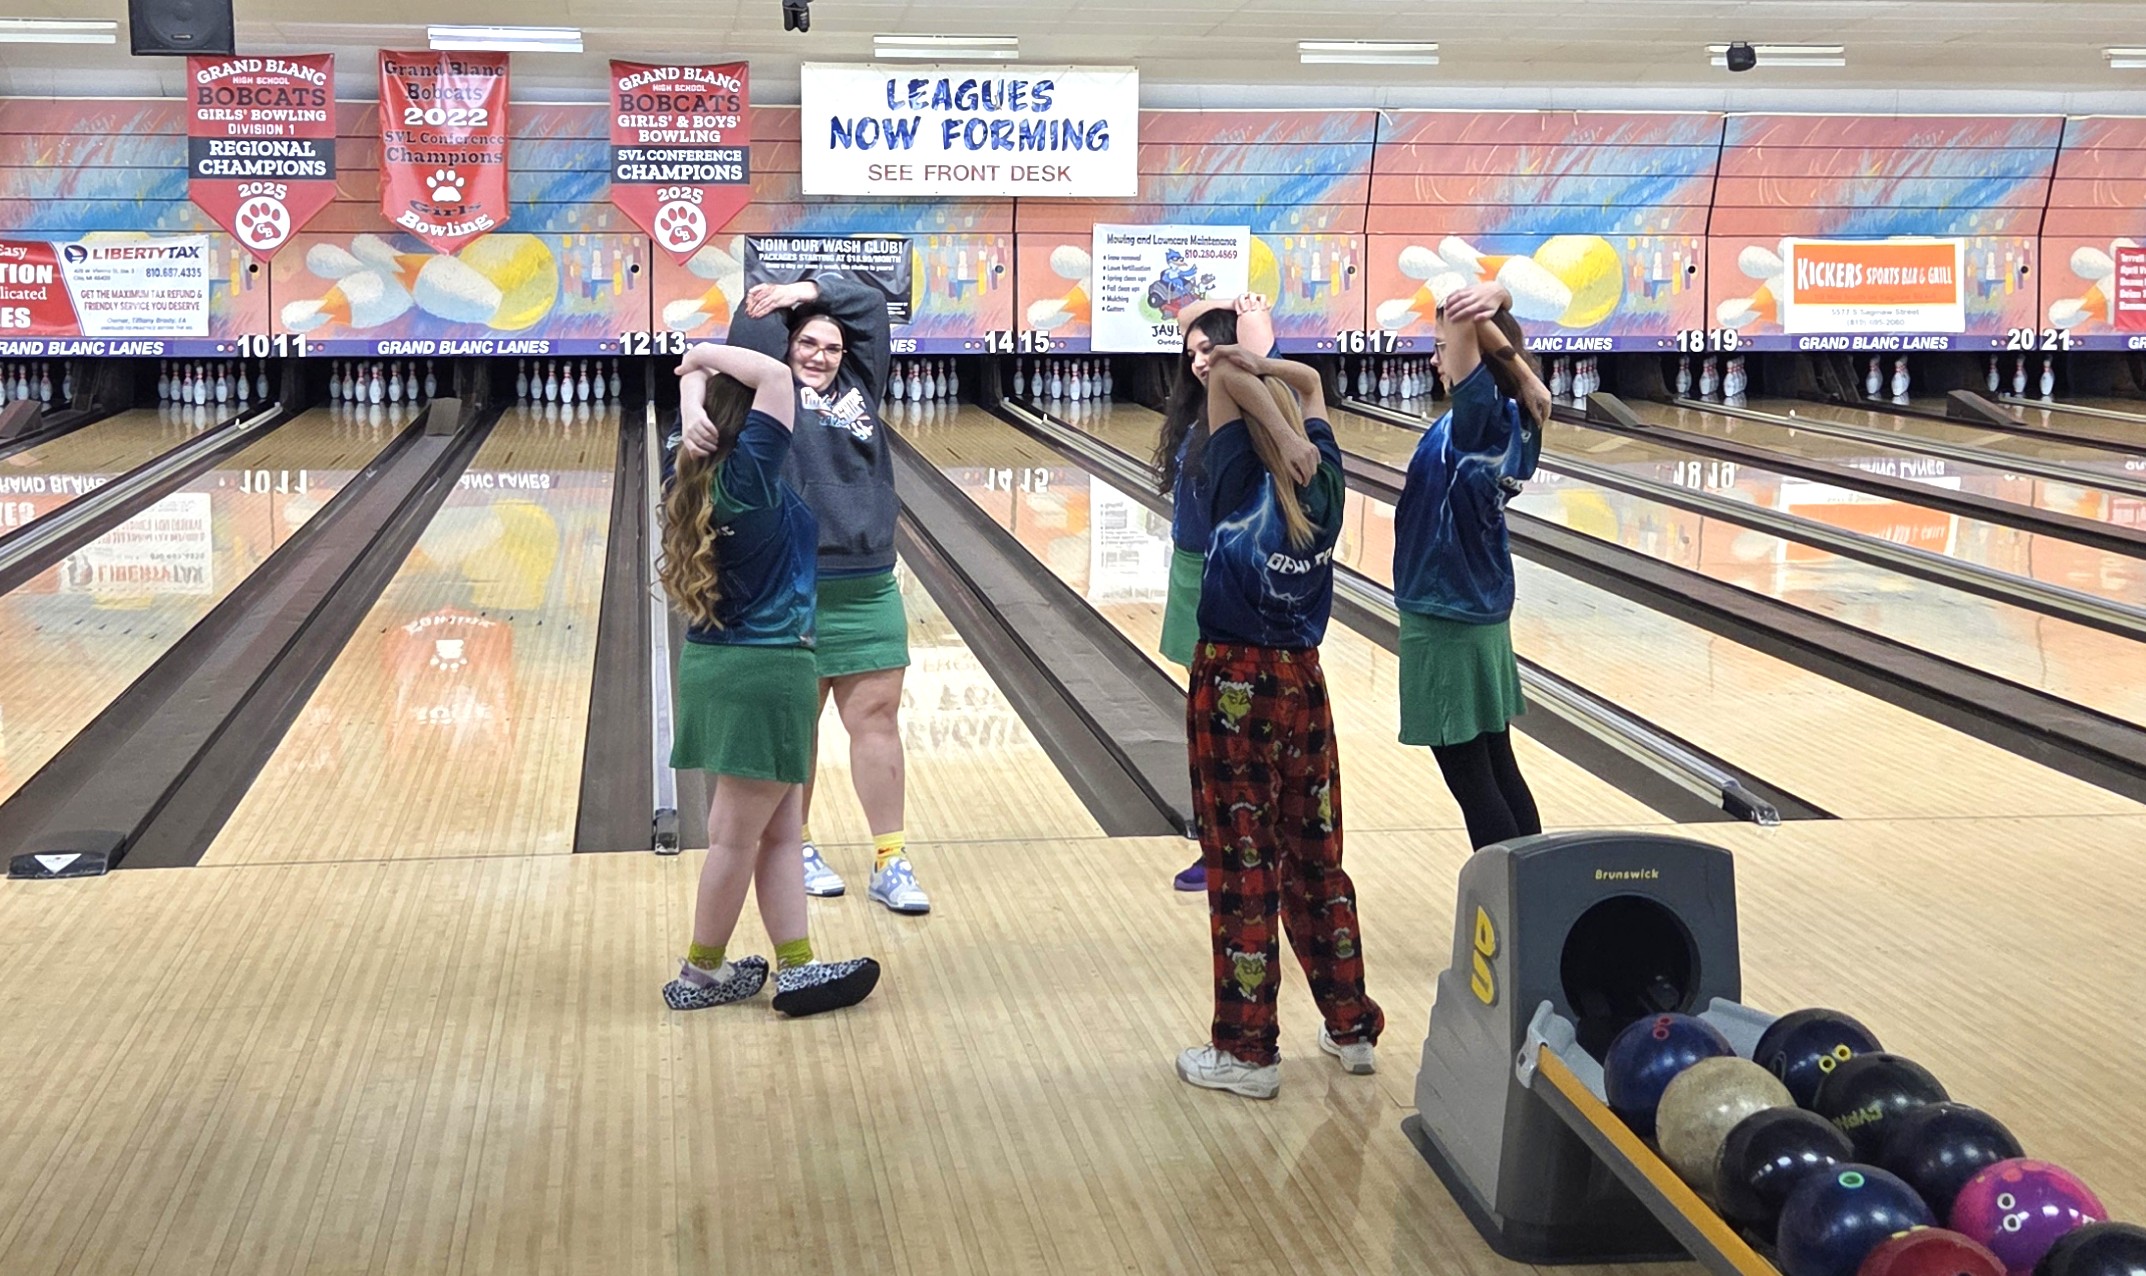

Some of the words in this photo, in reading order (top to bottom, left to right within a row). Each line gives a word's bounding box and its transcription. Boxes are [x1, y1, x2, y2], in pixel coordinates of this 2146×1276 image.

[196, 58, 263, 86] GRAND
[265, 58, 327, 86] BLANC
[384, 60, 442, 77] Grand
[450, 61, 505, 77] Blanc
[232, 77, 254, 85] HIGH
[256, 77, 290, 86] SCHOOL
[618, 66, 681, 92] GRAND
[683, 66, 742, 93] BLANC
[652, 84, 673, 92] HIGH
[674, 84, 707, 92] SCHOOL
[197, 87, 326, 107] BOBCATS
[405, 82, 483, 101] Bobcats
[886, 78, 1055, 112] LEAGUES
[618, 94, 741, 113] BOBCATS
[197, 109, 247, 121] GIRLS'
[251, 109, 327, 122] BOWLING
[404, 107, 488, 127] 2022
[617, 115, 673, 128] GIRLS'
[676, 115, 690, 128] &
[692, 115, 741, 129] BOYS'
[227, 124, 284, 136] DIVISION
[288, 124, 295, 136] 1
[384, 131, 416, 144] SVL
[419, 131, 505, 145] Conference
[638, 130, 721, 143] BOWLING
[830, 115, 922, 151] NOW
[941, 117, 1110, 152] FORMING
[209, 140, 316, 157] REGIONAL
[386, 147, 504, 167] Champions
[617, 150, 647, 161] SVL
[647, 150, 742, 162] CONFERENCE
[198, 159, 327, 176] CHAMPIONS
[617, 165, 743, 181] CHAMPIONS
[868, 164, 913, 182] SEE
[925, 164, 1001, 182] FRONT
[1010, 165, 1072, 182] DESK
[237, 182, 288, 200] 2025
[656, 186, 704, 204] 2025
[408, 200, 482, 217] Girls
[257, 223, 273, 238] GB
[396, 210, 496, 238] Bowling
[675, 226, 690, 241] GB
[1106, 234, 1135, 246] Mowing
[1137, 234, 1151, 245] and
[1153, 235, 1188, 246] Lawncare
[1190, 235, 1237, 247] Maintenance
[757, 239, 788, 251] JOIN
[791, 239, 820, 252] OUR
[821, 239, 861, 253] WASH
[864, 240, 903, 254] CLUB!
[759, 253, 797, 261] PACKAGES
[799, 254, 834, 262] STARTING
[836, 254, 845, 262] AT
[1797, 258, 1863, 290] KICKERS
[1866, 267, 1900, 285] SPORTS
[1901, 267, 1918, 285] BAR
[1927, 267, 1952, 285] GRILL
[81, 290, 94, 299] GET
[96, 290, 110, 299] THE
[111, 290, 149, 299] MAXIMUM
[151, 290, 165, 299] TAX
[167, 289, 195, 298] REFUND
[197, 290, 203, 298] &
[84, 302, 118, 310] FRIENDLY
[120, 302, 150, 310] SERVICE
[152, 302, 168, 310] YOU
[168, 302, 200, 310] DESERVE
[1, 307, 31, 328] ES
[1151, 324, 1174, 337] JAY
[237, 335, 270, 358] 10
[273, 334, 307, 358] 11
[377, 341, 437, 355] GRAND
[439, 341, 495, 355] BLANC
[497, 341, 550, 354] LANES
[619, 332, 650, 355] 12
[655, 332, 686, 354] 13
[889, 339, 917, 353] NES
[985, 330, 1014, 353] 14
[1020, 330, 1050, 353] 15
[1336, 331, 1364, 353] 16
[1369, 330, 1398, 353] 17
[1525, 337, 1562, 351] LANC
[1565, 337, 1612, 351] LANES
[1676, 330, 1704, 352] 18
[1710, 329, 1738, 351] 19
[1799, 336, 1850, 350] GRAND
[1852, 336, 1899, 350] BLANC
[1903, 336, 1949, 350] LANES
[2007, 328, 2034, 350] 20
[2041, 329, 2070, 351] 21
[48, 341, 105, 355] BLANC
[108, 341, 165, 356] LANES
[1595, 868, 1660, 880] Brunswick
